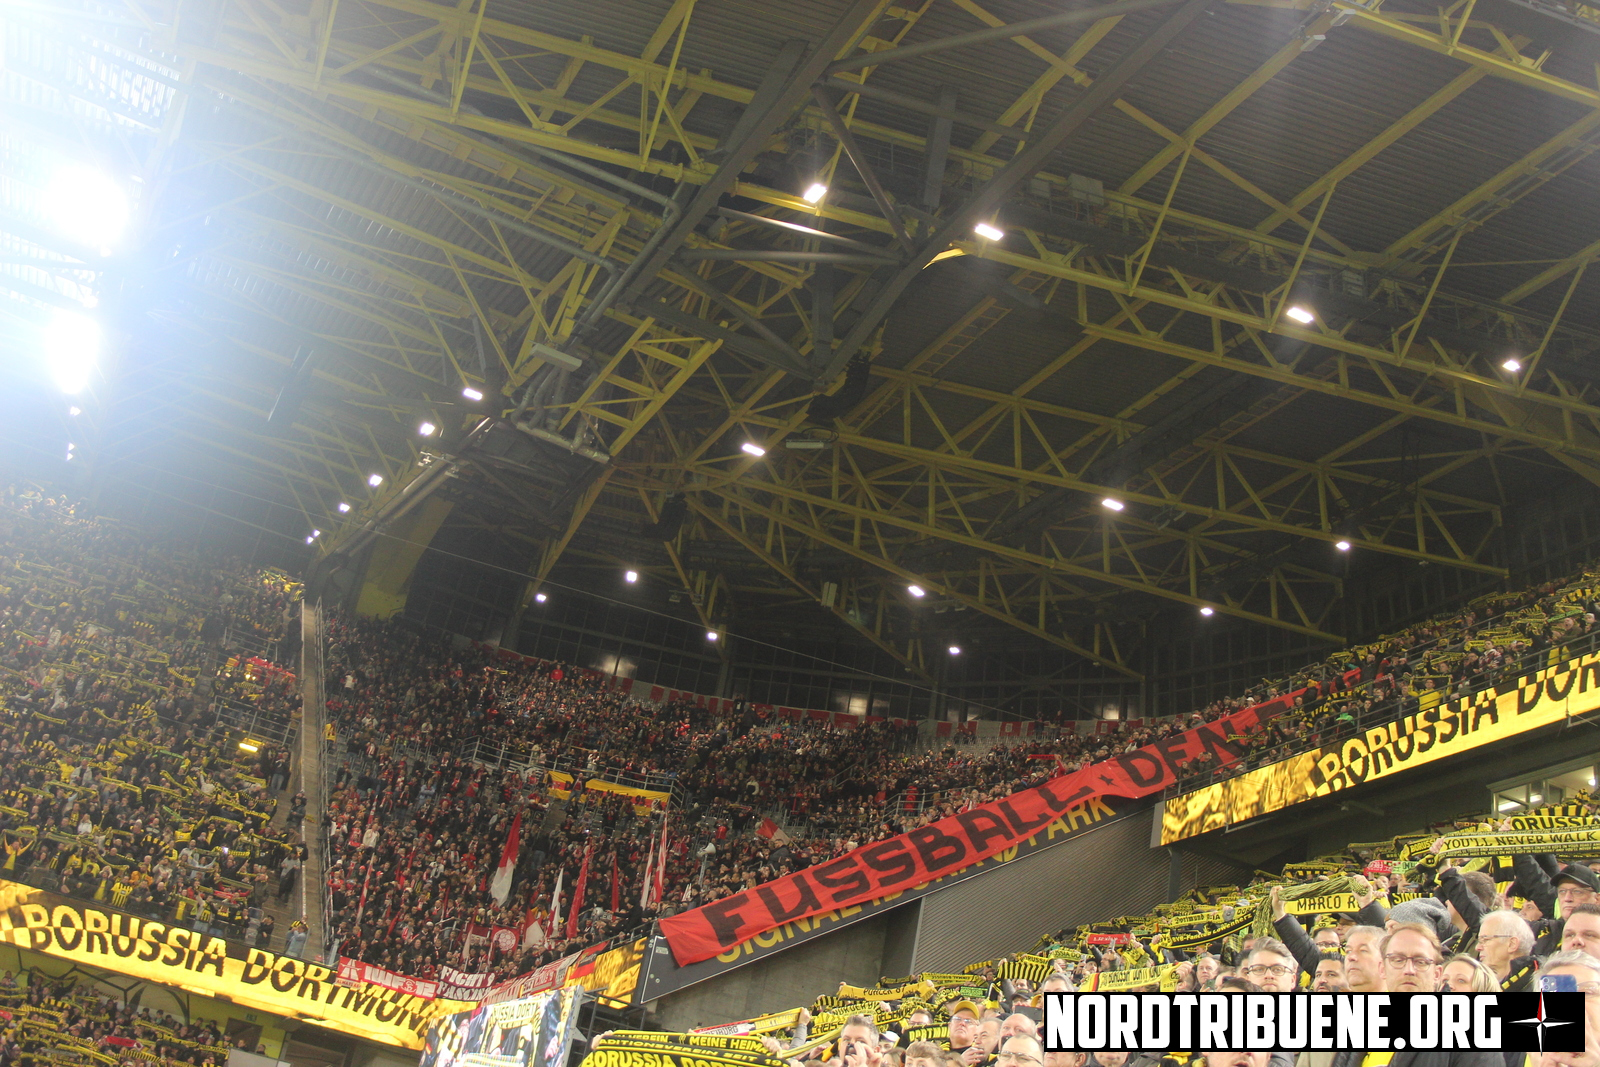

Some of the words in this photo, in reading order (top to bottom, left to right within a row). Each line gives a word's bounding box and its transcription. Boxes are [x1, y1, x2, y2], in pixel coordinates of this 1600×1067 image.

[1317, 687, 1500, 791] BORUSSIA
[1444, 837, 1493, 851] YOU'LL
[1494, 835, 1544, 846] NEVER
[1549, 831, 1598, 843] WALK
[701, 785, 1096, 947] FUSSBALL
[1297, 895, 1341, 912] MARCO
[22, 904, 227, 977] BORUSSIA
[440, 966, 487, 987] FIGHT
[689, 1036, 728, 1048] MEINE
[723, 1052, 758, 1062] SEIT
